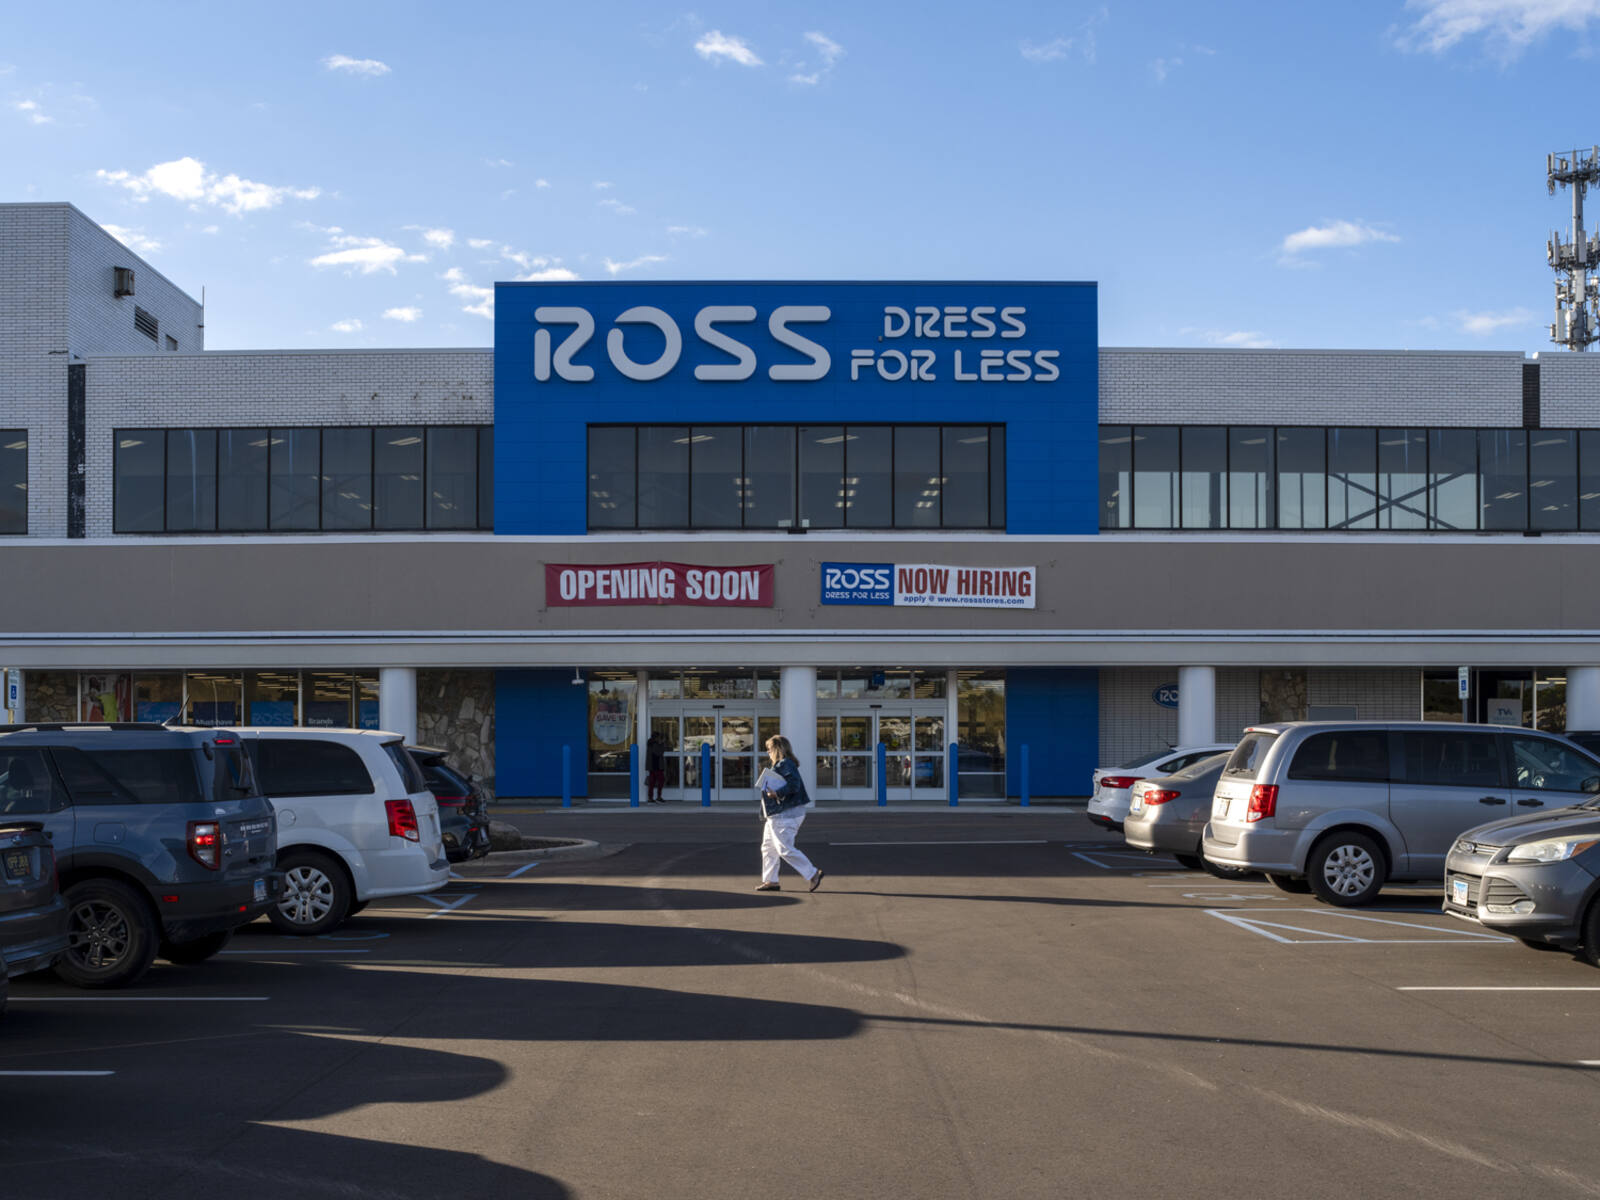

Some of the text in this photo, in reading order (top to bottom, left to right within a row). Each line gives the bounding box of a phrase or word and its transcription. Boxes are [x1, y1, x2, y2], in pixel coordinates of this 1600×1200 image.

[884, 306, 1027, 338] DRESS
[534, 305, 832, 381] ROSS
[851, 349, 1060, 381] FOR LESS
[560, 568, 759, 600] OPENING SOON
[826, 569, 890, 589] ROSS
[898, 568, 1031, 597] NOW HIRING
[852, 592, 868, 600] FOR
[870, 592, 890, 600] LESS
[904, 595, 926, 603] apply
[937, 597, 1025, 605] www.rossstores.com
[1160, 690, 1179, 702] RO
